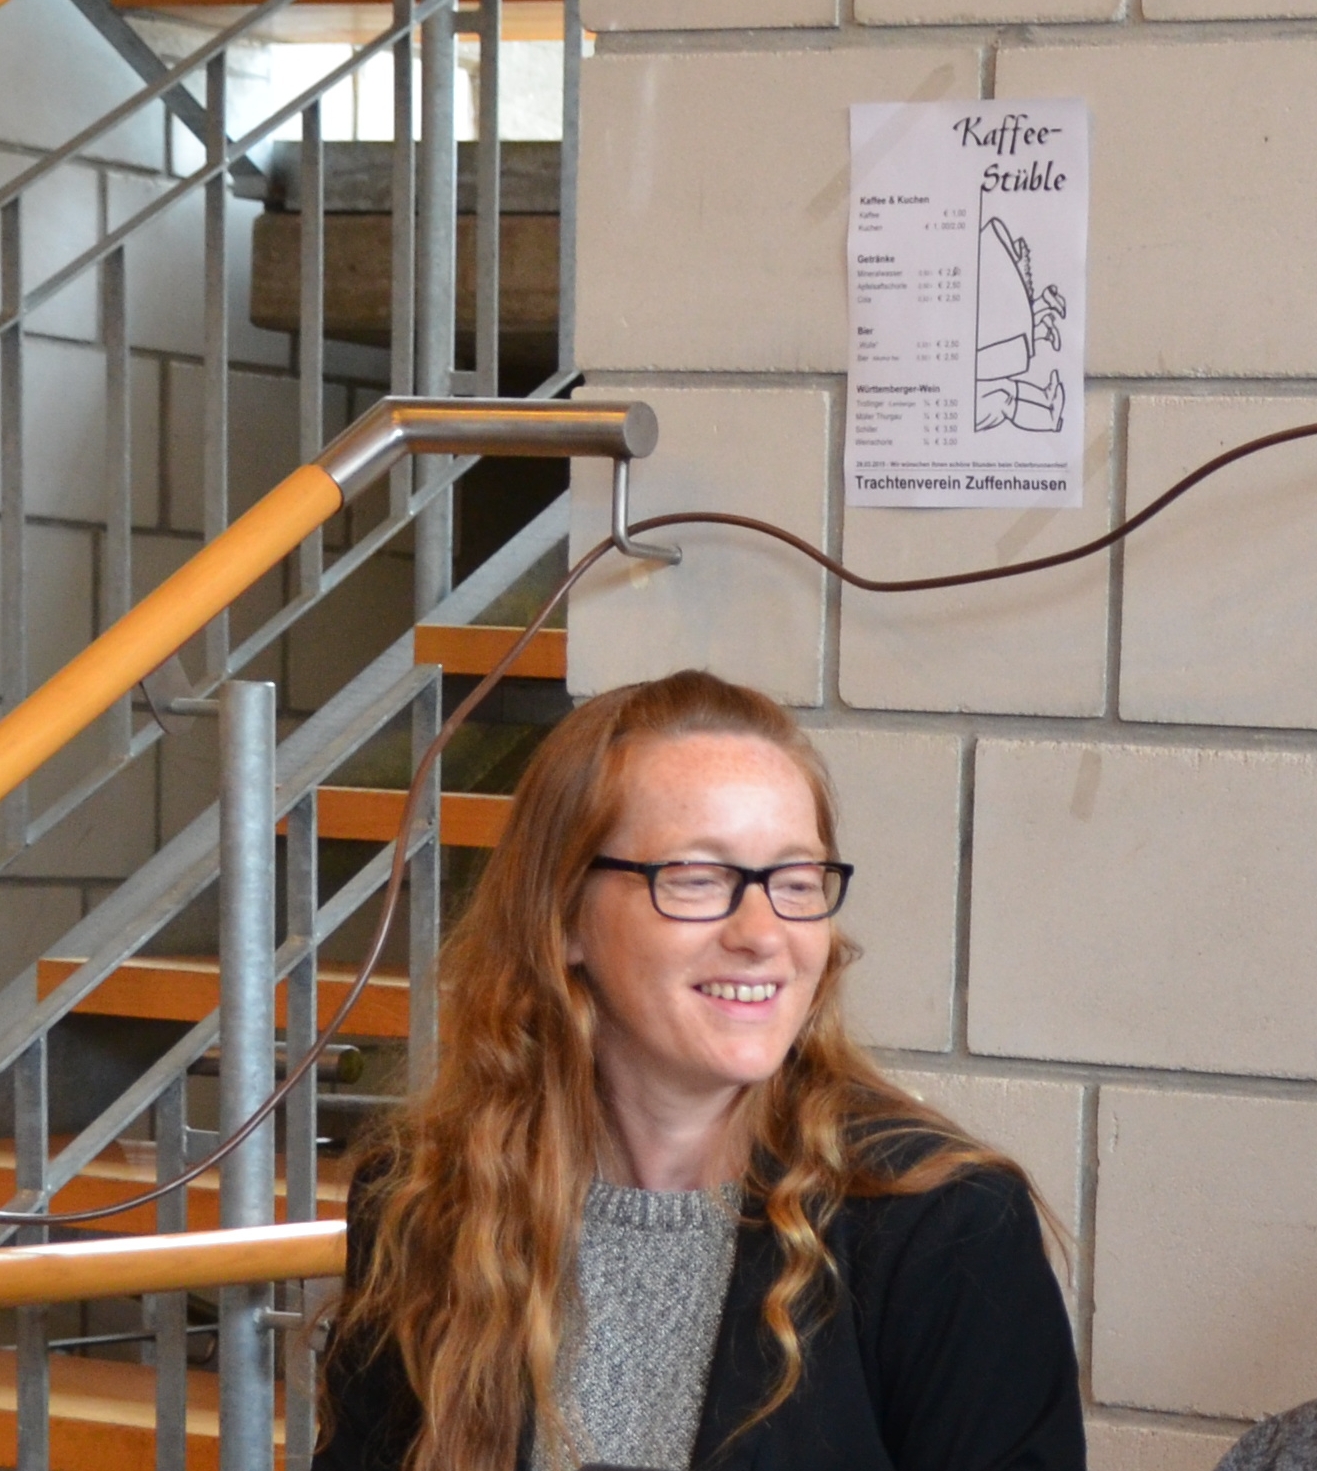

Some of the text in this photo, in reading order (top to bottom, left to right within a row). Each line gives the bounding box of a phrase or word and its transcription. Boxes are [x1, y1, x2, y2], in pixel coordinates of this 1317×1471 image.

[953, 113, 1062, 155] Kaffee-
[981, 160, 1066, 193] Stüble
[860, 195, 930, 205] Kaffee & Kuchen
[857, 254, 895, 264] Getränke
[857, 326, 874, 335] Bier
[856, 384, 940, 395] Württemberger-Wein
[855, 475, 1066, 491] Trachtenverein Zuffenhausen
